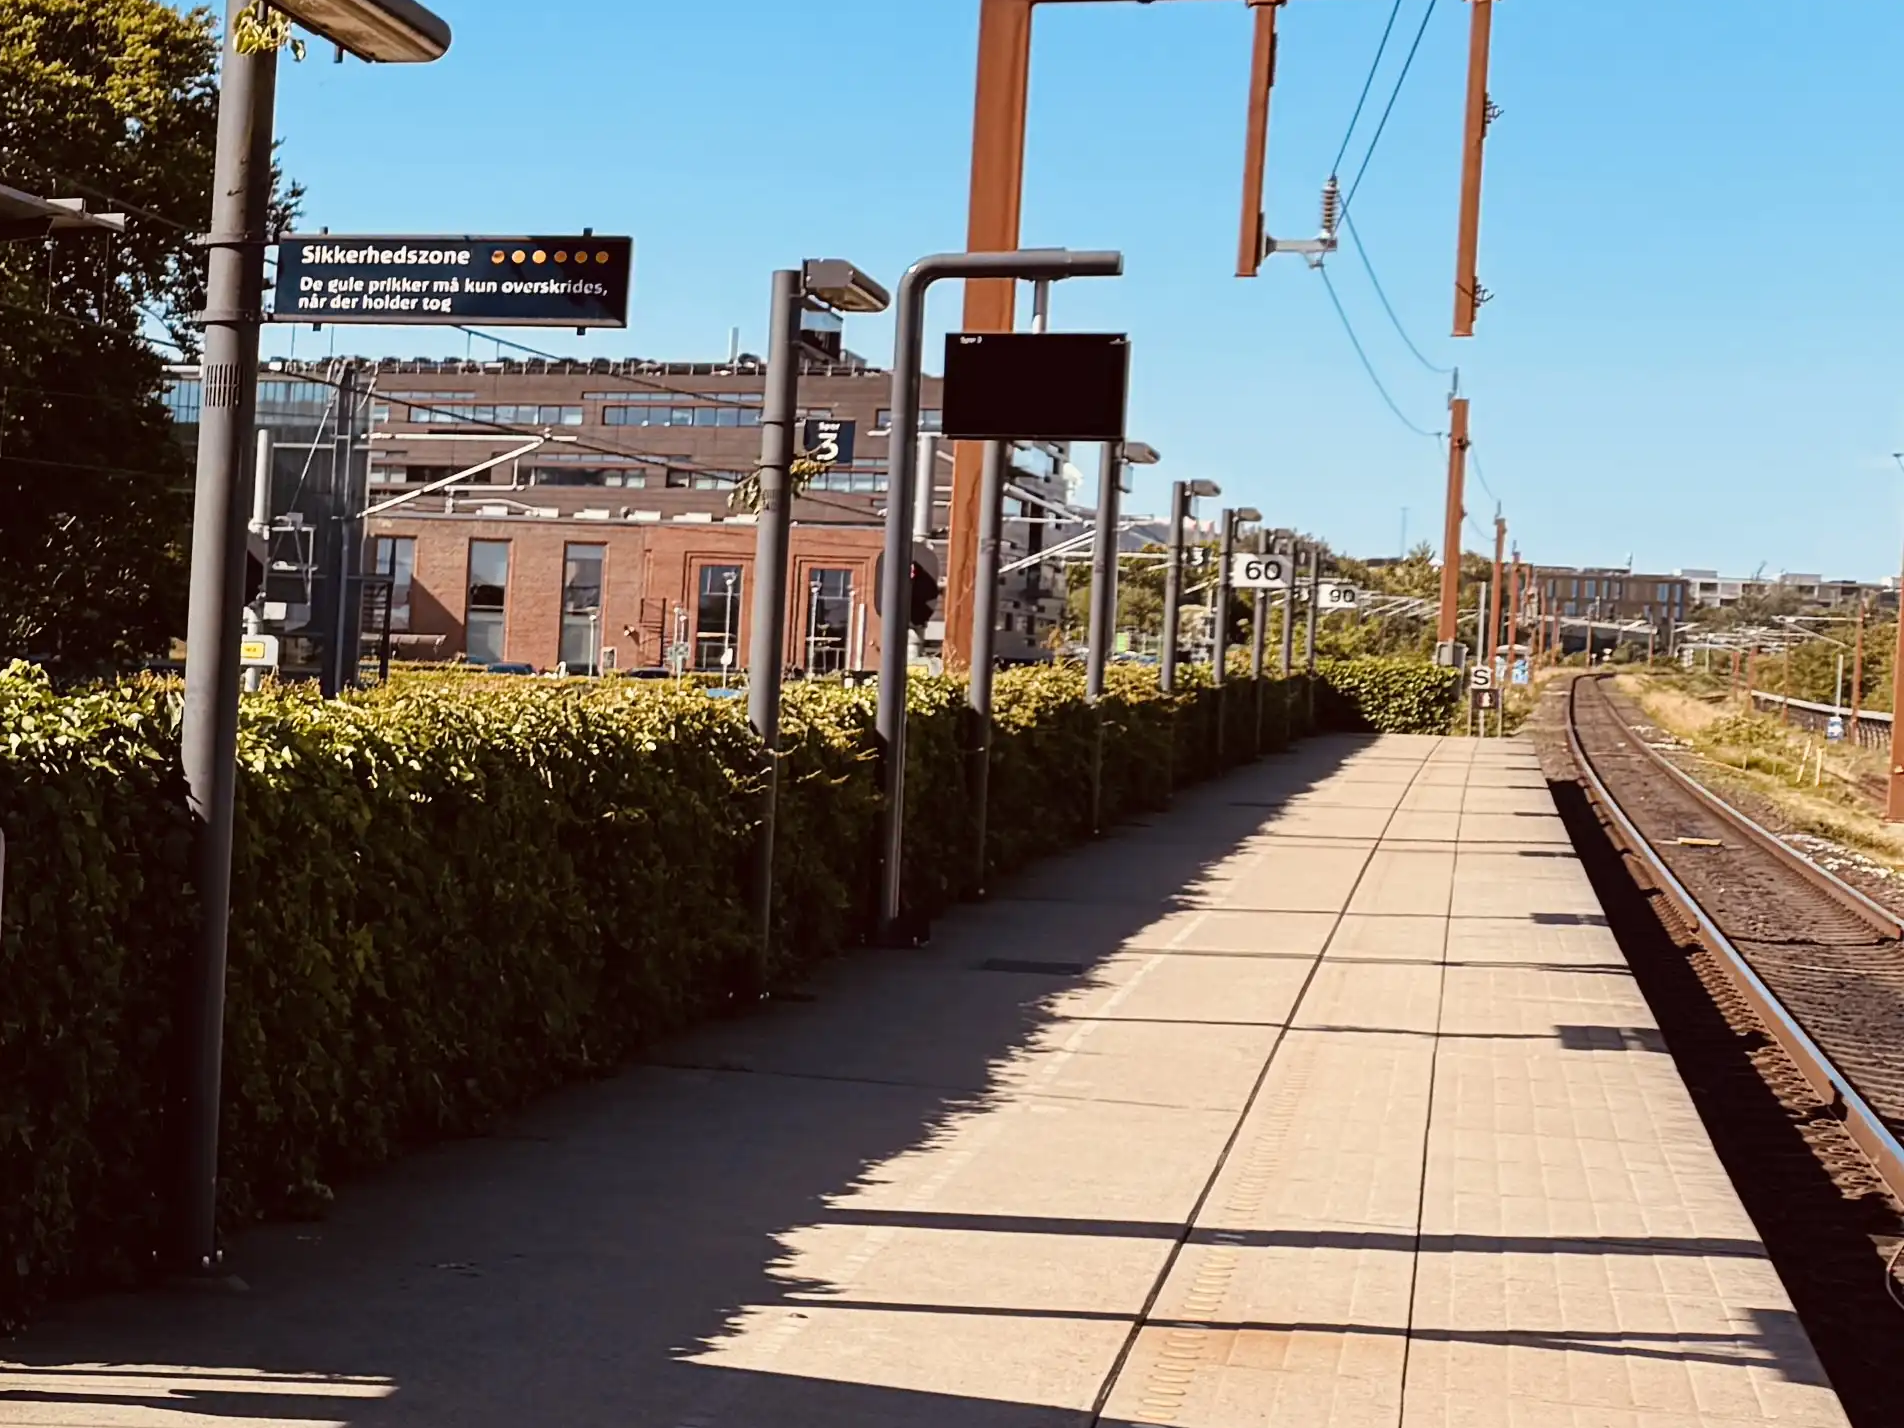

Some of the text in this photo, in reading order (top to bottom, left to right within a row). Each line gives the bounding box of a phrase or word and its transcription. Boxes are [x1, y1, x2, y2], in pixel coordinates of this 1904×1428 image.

[301, 244, 471, 265] Sikkerhedszone
[300, 276, 608, 296] De gule prikker må kun overskrides,
[298, 293, 453, 313] når der holder tog
[816, 433, 839, 461] 3
[1245, 560, 1282, 581] 60
[1330, 589, 1356, 603] 90
[1473, 669, 1489, 686] S
